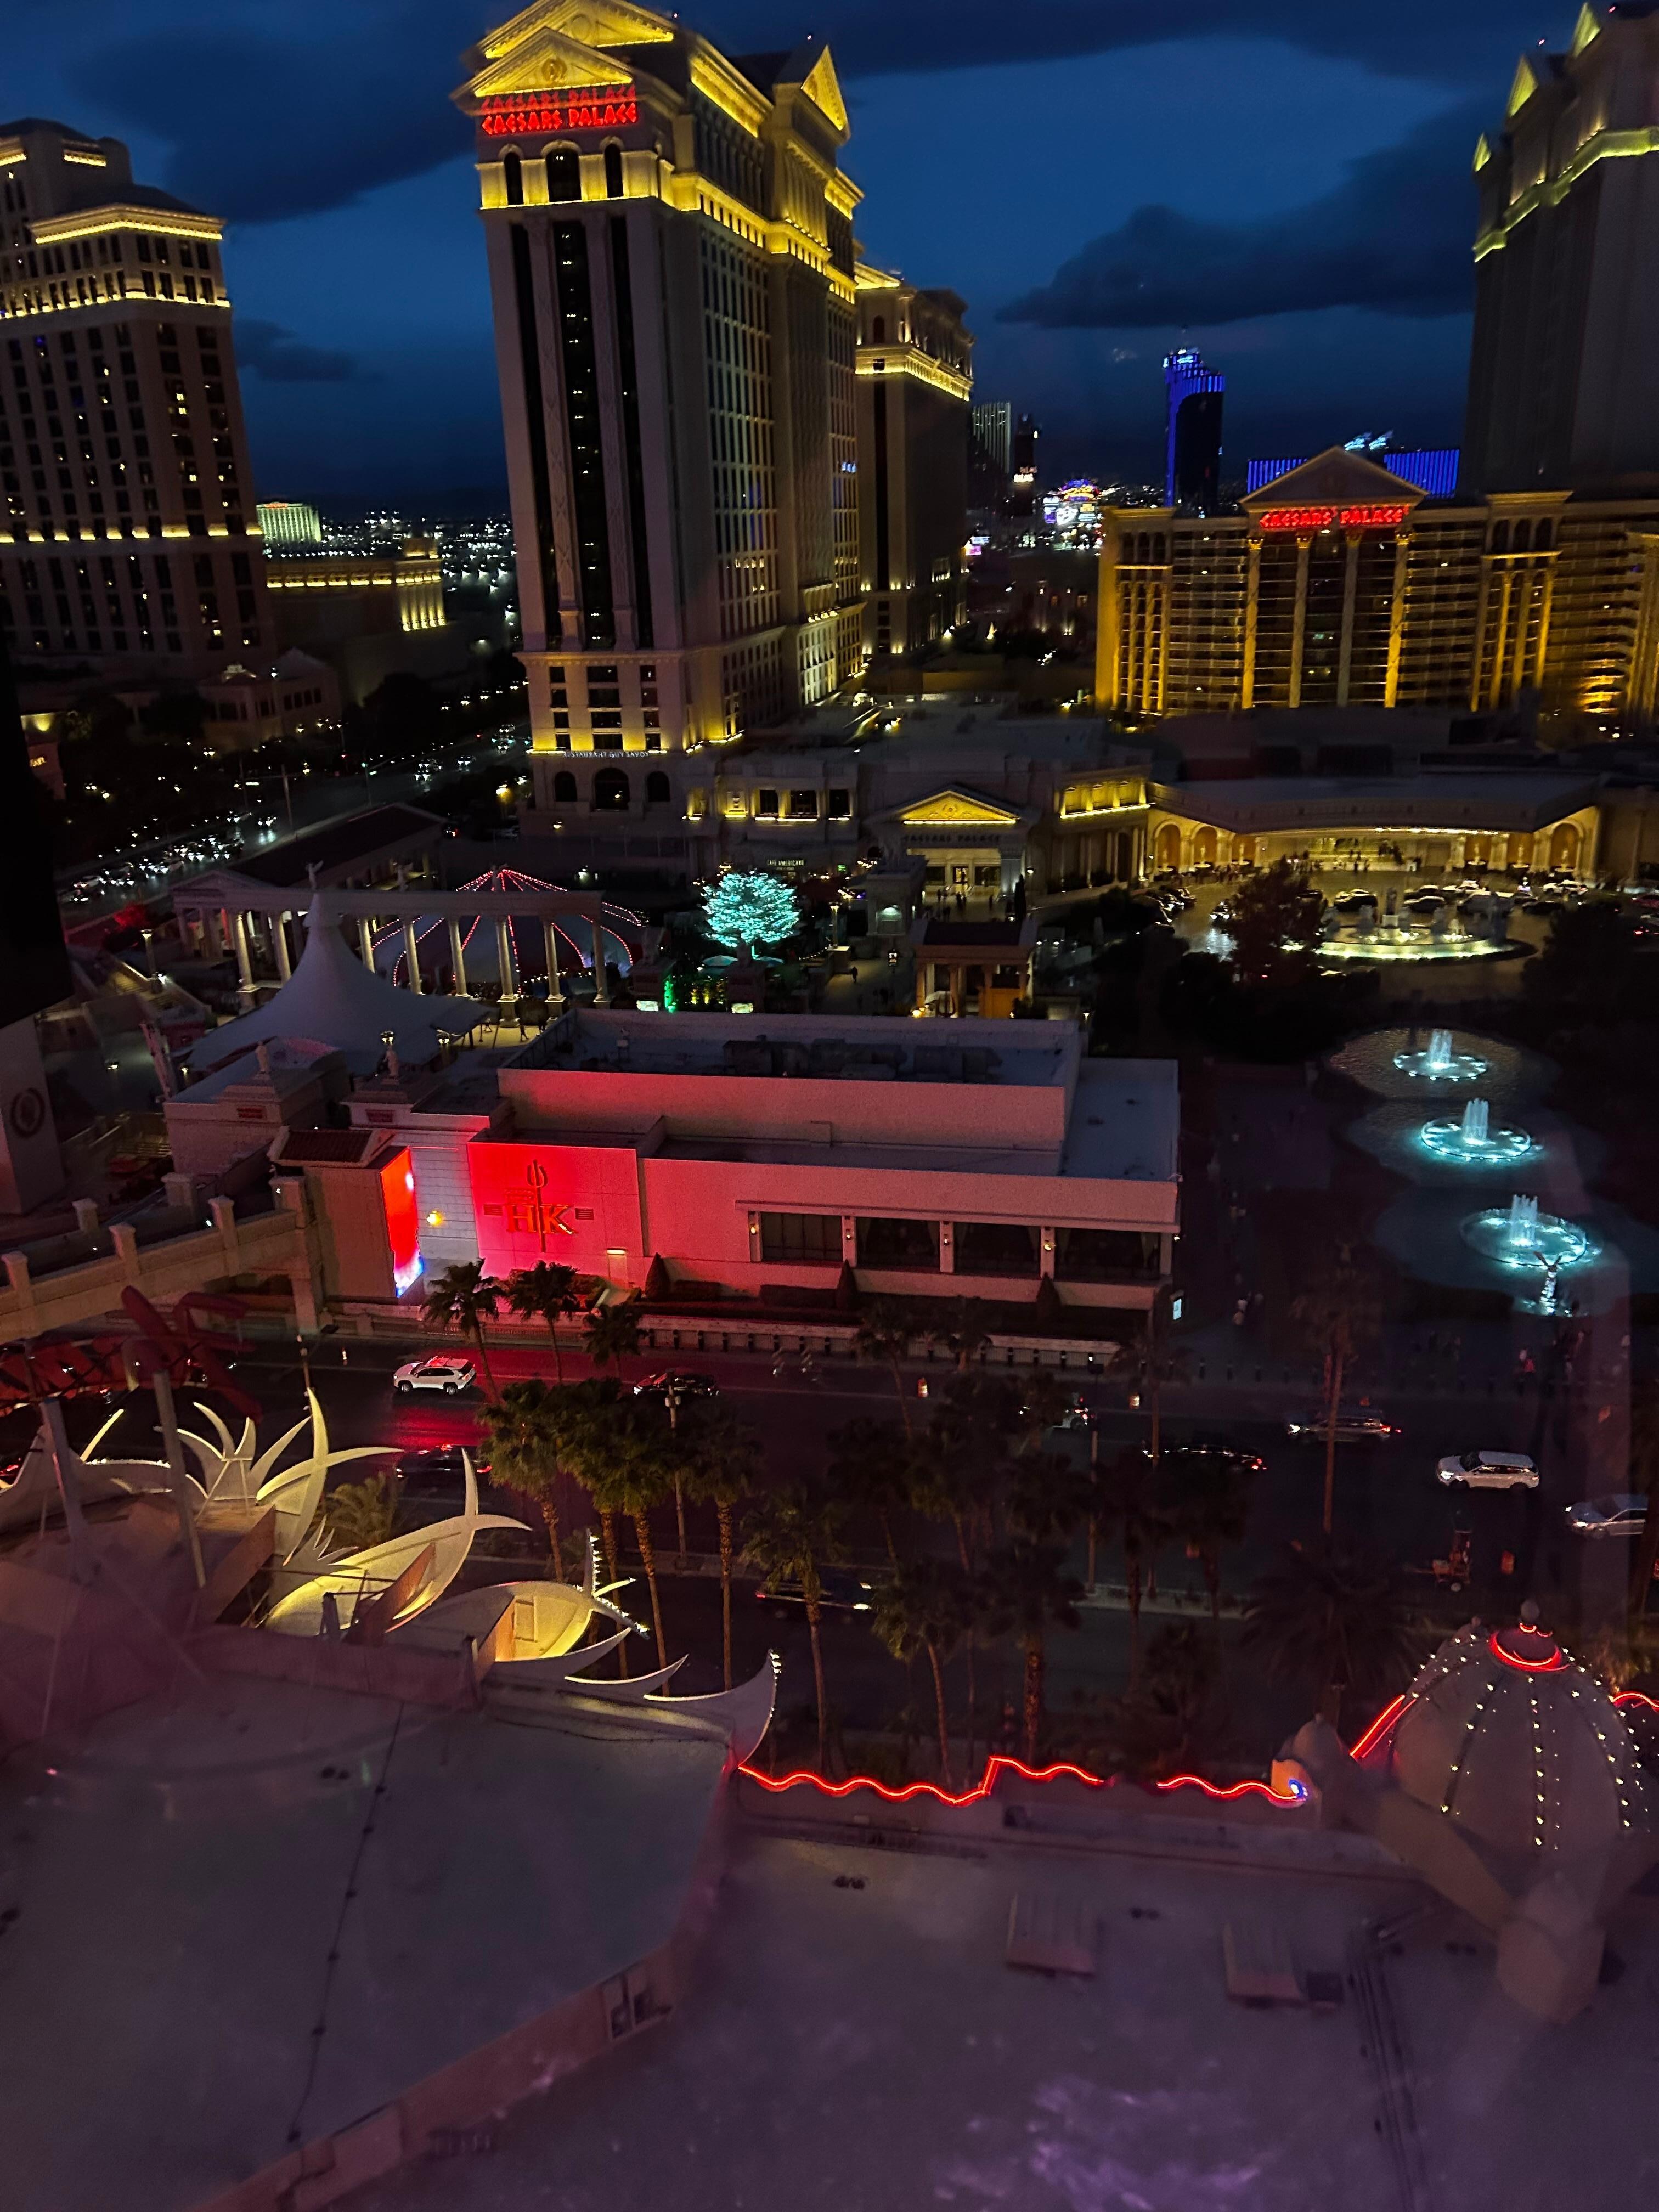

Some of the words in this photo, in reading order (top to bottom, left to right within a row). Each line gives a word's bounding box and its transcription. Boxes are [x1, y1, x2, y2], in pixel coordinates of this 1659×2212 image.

[482, 110, 563, 134] CAESARS
[568, 103, 637, 127] PALACE
[1260, 511, 1332, 527] CAESARS
[1339, 509, 1403, 525] PALACE
